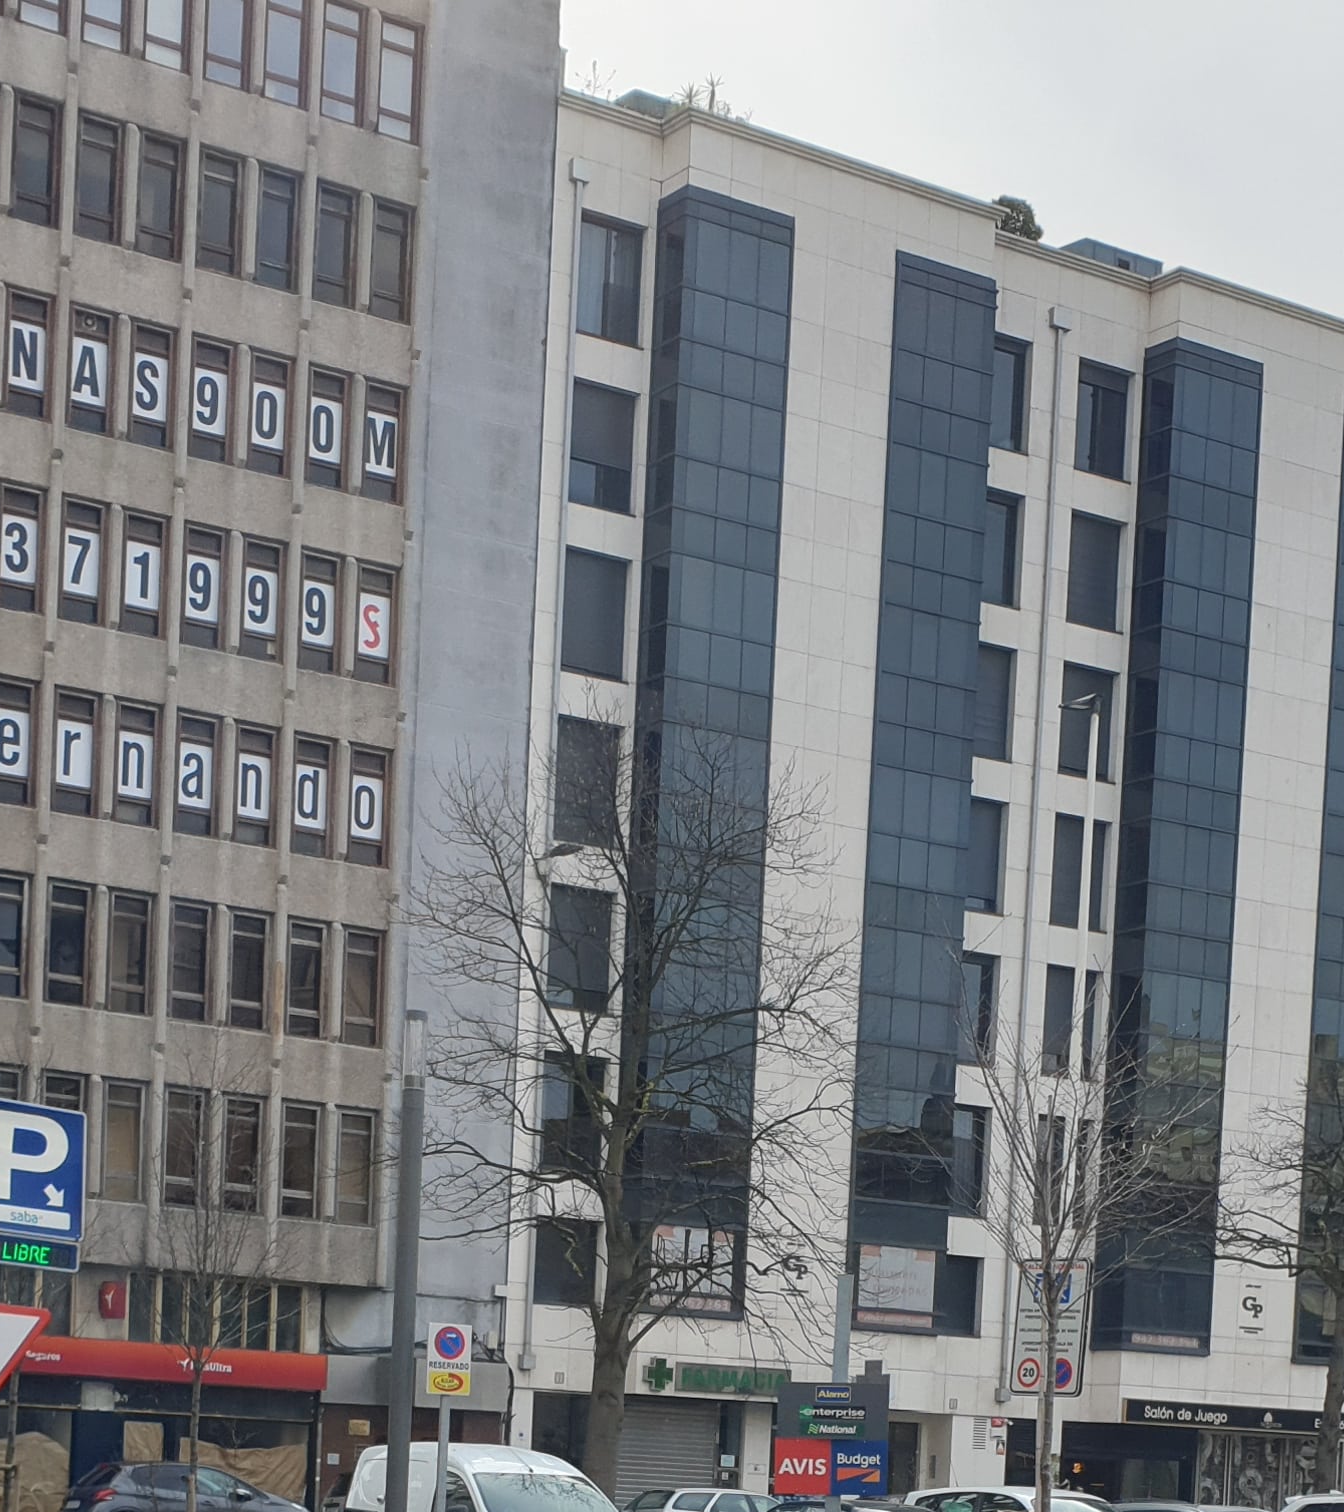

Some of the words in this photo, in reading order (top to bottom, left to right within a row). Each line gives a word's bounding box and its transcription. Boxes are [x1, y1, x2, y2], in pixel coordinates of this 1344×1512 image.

[9, 1210, 39, 1224] saba
[1, 1241, 51, 1265] LIBRE
[429, 1361, 470, 1370] RESERVADO
[1022, 1367, 1035, 1378] 20
[817, 1390, 850, 1399] Alamo
[803, 1408, 866, 1418] enterprise
[1144, 1405, 1174, 1421] Salón
[1177, 1408, 1192, 1421] de
[1195, 1410, 1228, 1425] Juego
[819, 1425, 857, 1435] National
[778, 1458, 827, 1475] AVIS
[837, 1453, 881, 1468] Budget
